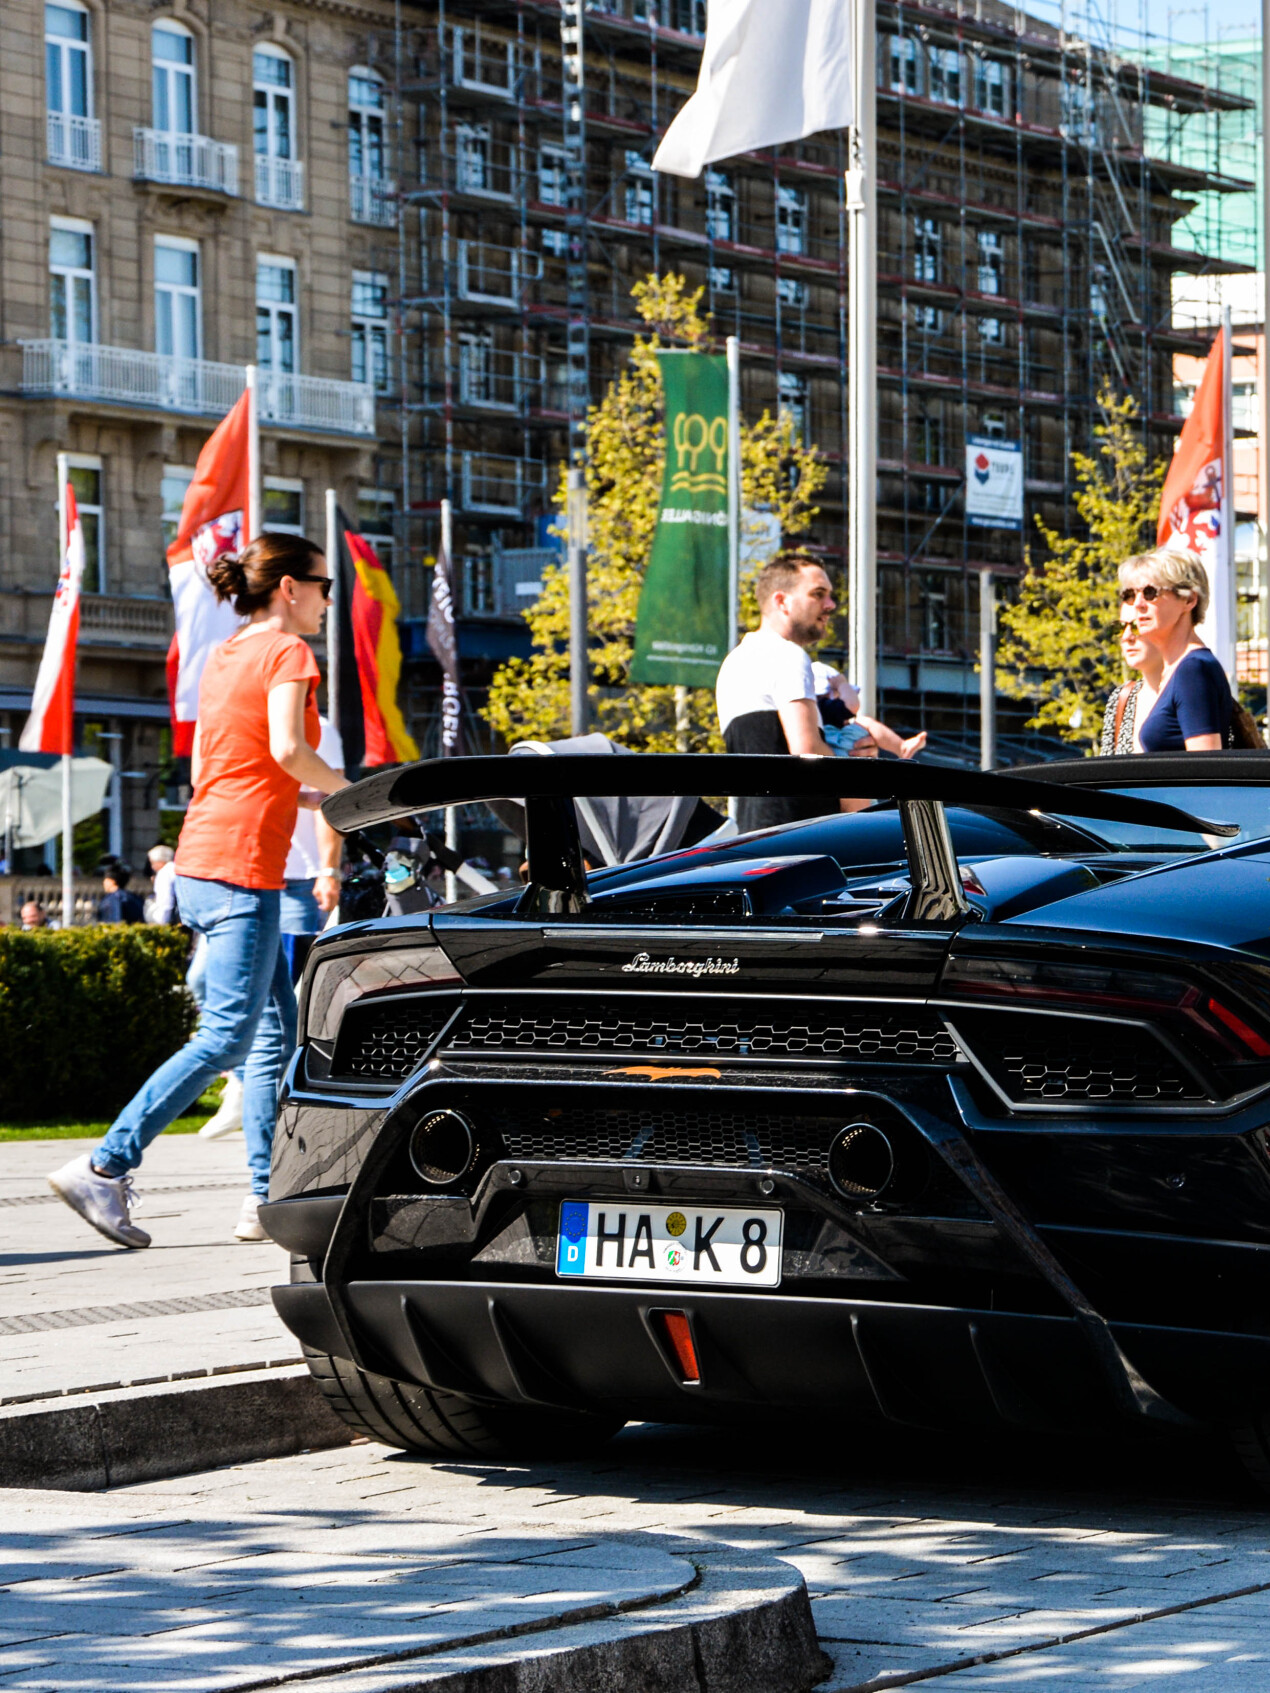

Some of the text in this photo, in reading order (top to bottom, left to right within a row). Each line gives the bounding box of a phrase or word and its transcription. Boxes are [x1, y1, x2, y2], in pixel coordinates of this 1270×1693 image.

[621, 952, 740, 978] Lamborghini
[567, 1246, 579, 1262] D
[596, 1212, 656, 1269] HA
[693, 1216, 725, 1272] K
[740, 1218, 767, 1274] 8
